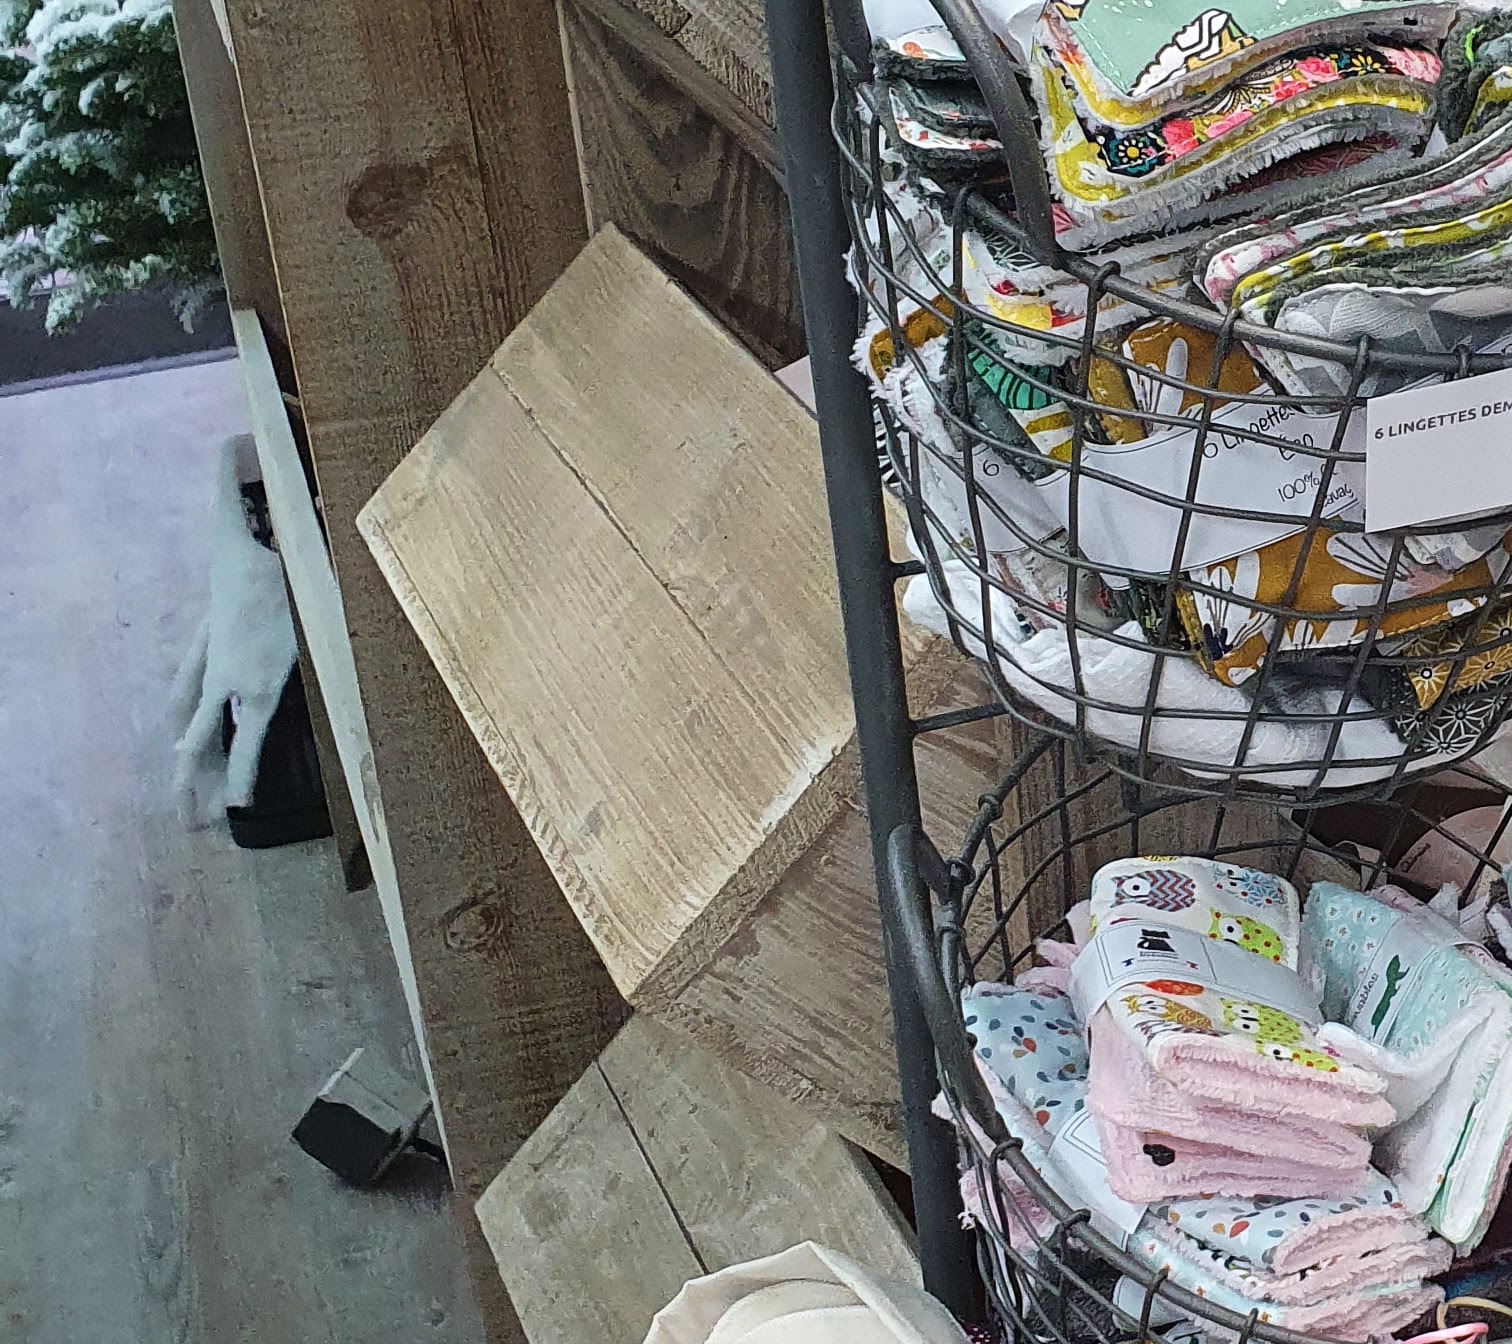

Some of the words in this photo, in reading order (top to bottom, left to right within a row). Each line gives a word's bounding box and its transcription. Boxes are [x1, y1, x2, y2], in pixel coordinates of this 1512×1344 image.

[1374, 427, 1384, 440] 6
[1388, 407, 1476, 438] LINGETTES
[983, 459, 999, 476] 6
[1278, 471, 1320, 503] 100%
